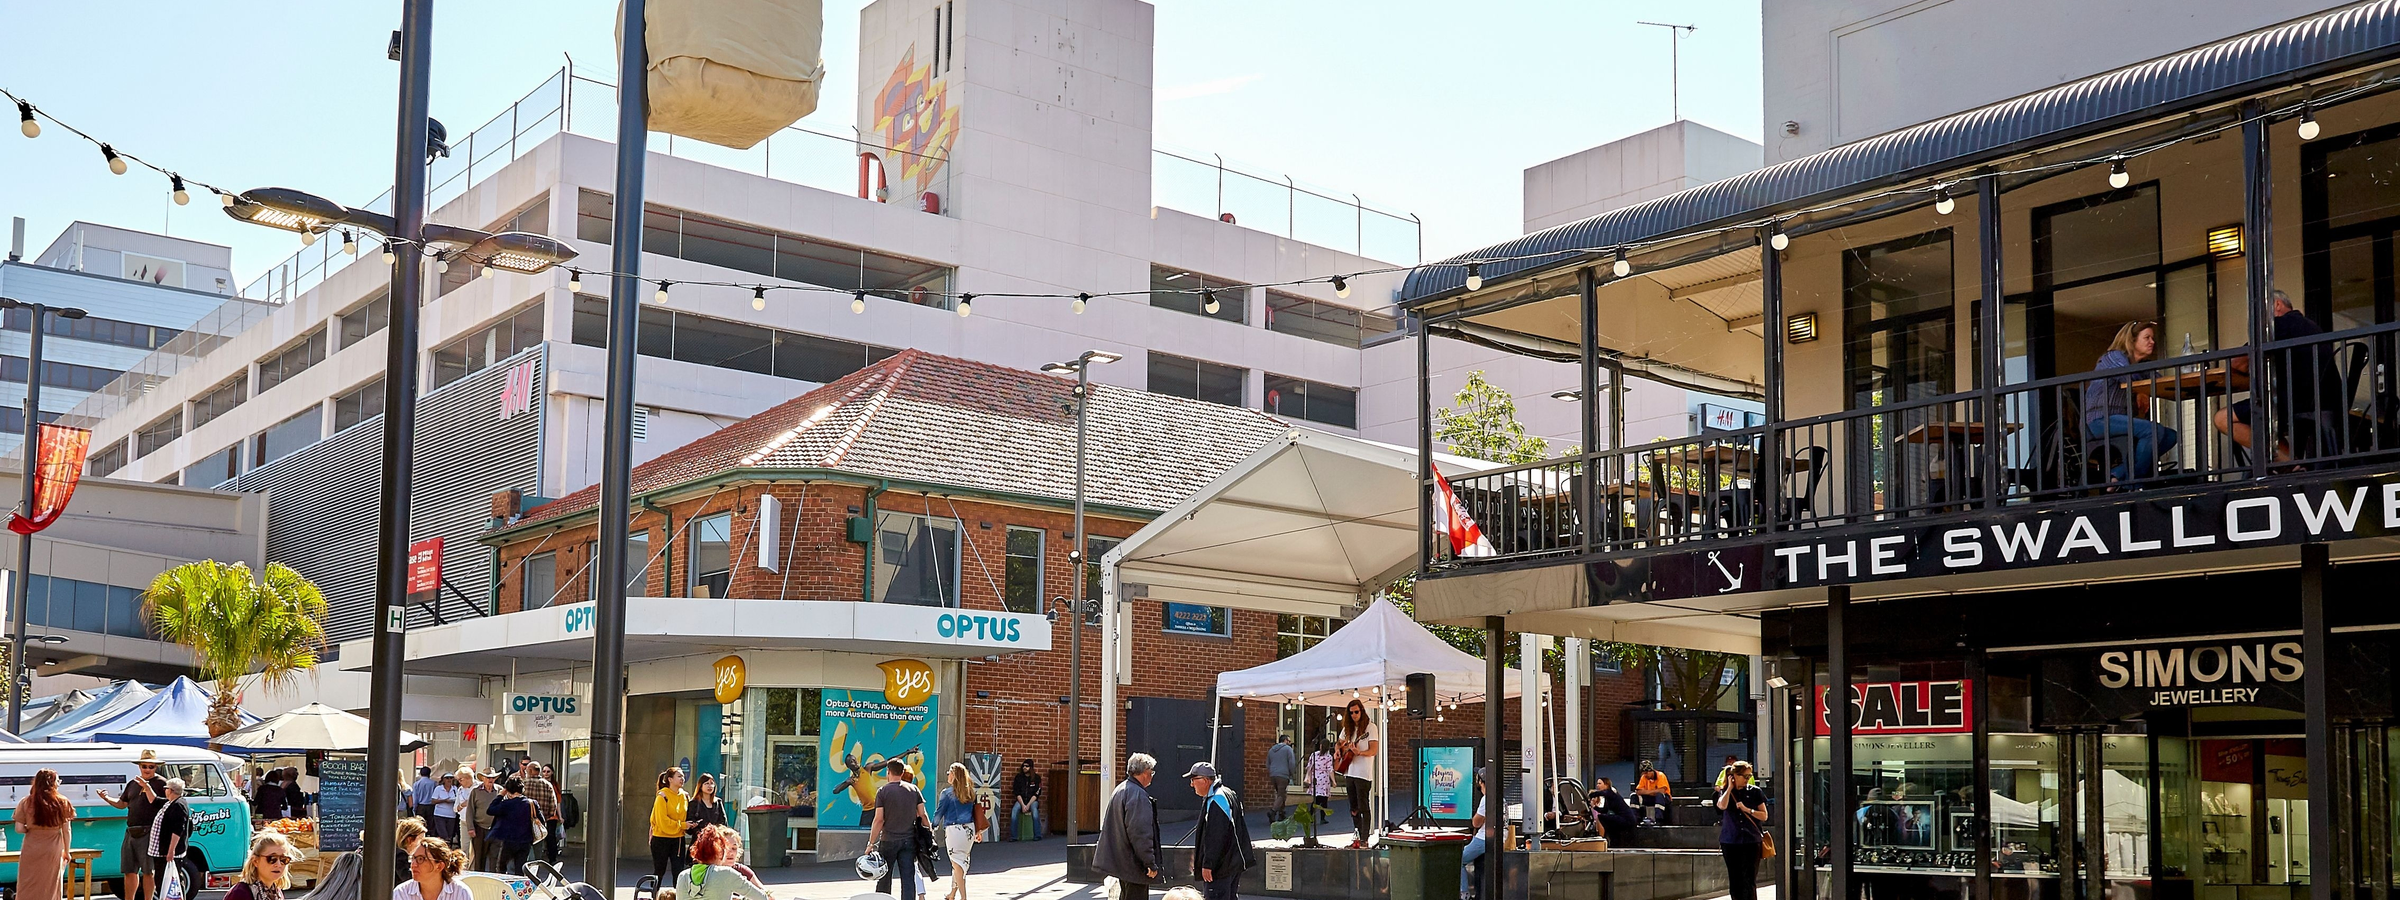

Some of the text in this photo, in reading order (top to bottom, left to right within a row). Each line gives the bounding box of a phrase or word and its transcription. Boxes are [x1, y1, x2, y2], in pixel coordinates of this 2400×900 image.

[1774, 535, 1907, 583] THE
[390, 610, 403, 629] H
[937, 613, 1021, 642] OPTUS
[2098, 642, 2304, 689] SIMONS
[716, 665, 737, 697] yes
[895, 668, 931, 699] yes
[512, 695, 576, 714] OPTUS
[825, 698, 849, 709] Optus
[850, 701, 862, 709] 4G
[863, 702, 880, 711] Plus,
[2149, 687, 2260, 707] JEWELLERY
[825, 710, 845, 718] more
[846, 711, 889, 720] Australians
[889, 712, 907, 721] than
[1854, 742, 1885, 750] SIMONS
[350, 762, 365, 771] BAR
[192, 809, 230, 825] Kombi
[199, 821, 225, 836] Keg
